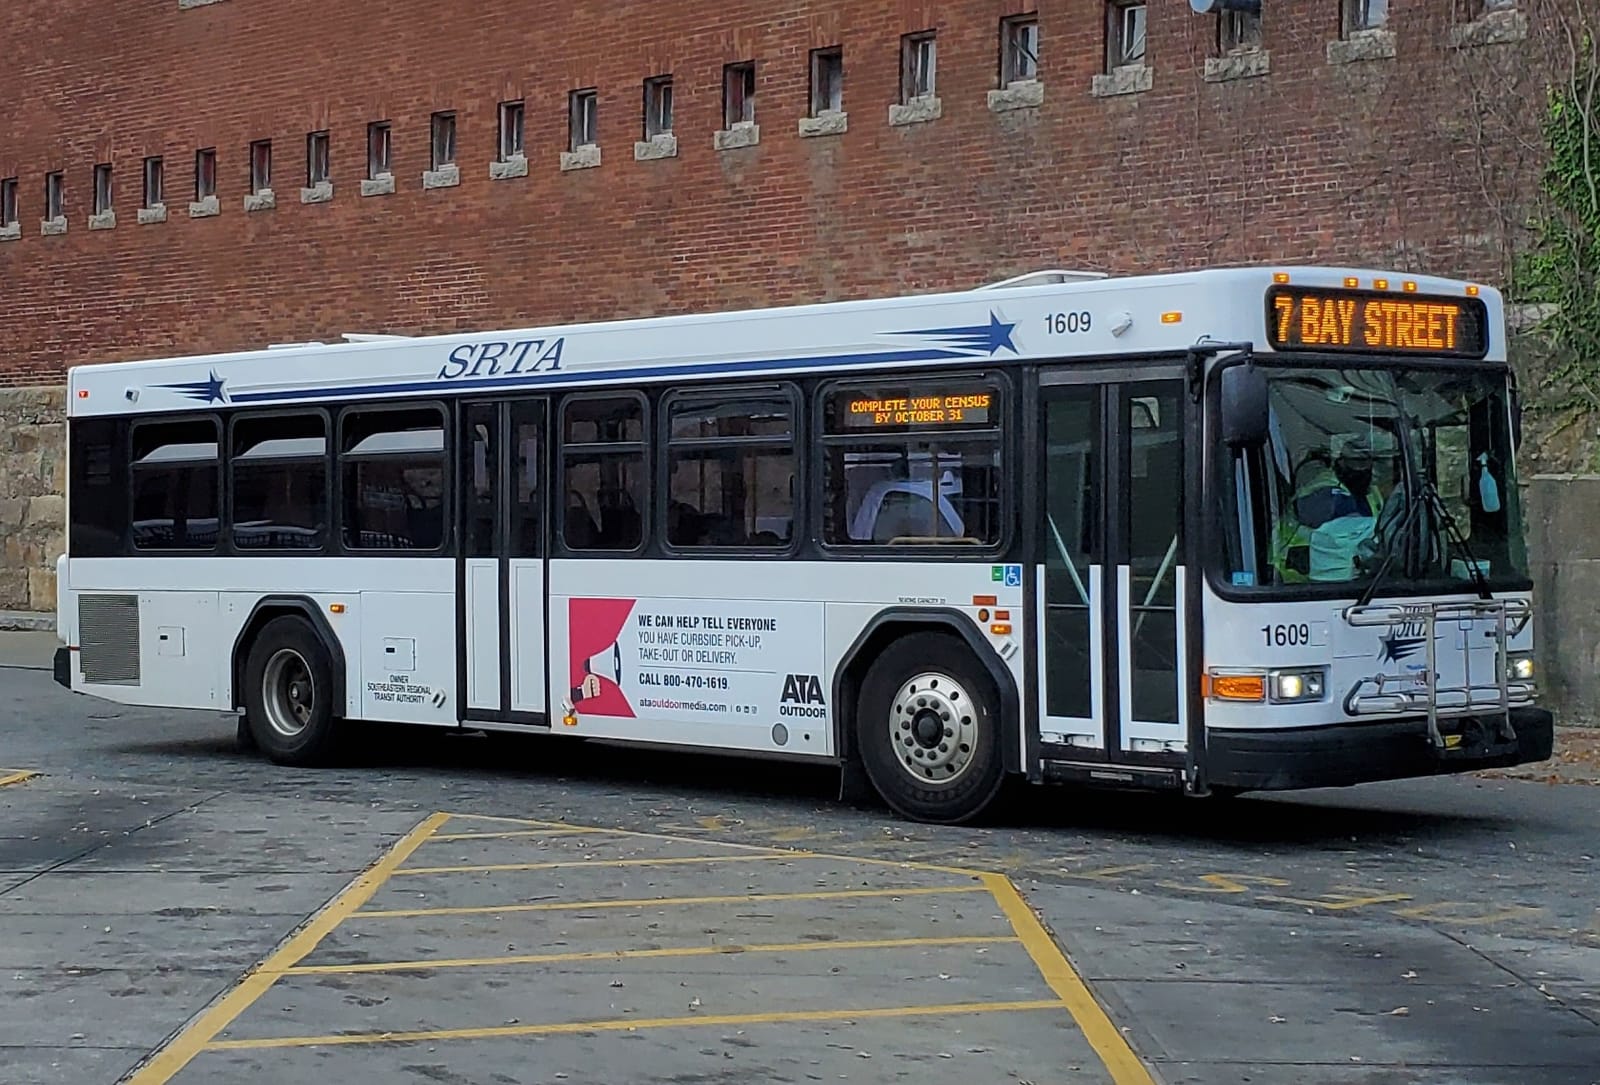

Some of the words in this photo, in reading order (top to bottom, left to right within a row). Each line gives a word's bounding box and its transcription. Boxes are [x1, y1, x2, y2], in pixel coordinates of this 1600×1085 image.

[1044, 311, 1091, 335] 1609
[1274, 296, 1294, 342] 7
[1301, 297, 1356, 344] BAY
[1363, 301, 1459, 349] STREET
[437, 337, 565, 379] SRTA
[851, 400, 907, 413] COMPLETE
[912, 398, 941, 411] YOUR
[944, 395, 989, 408] CENSUS
[875, 413, 891, 424] BY
[895, 411, 945, 423] OCTOBER
[949, 409, 963, 420] 31
[638, 615, 653, 628] WE
[655, 615, 674, 628] CAN
[676, 616, 700, 629] HELP
[702, 617, 725, 630] TELL
[727, 618, 777, 632] EVERYONE
[638, 631, 656, 644] YOU
[657, 632, 679, 645] HAVE
[681, 633, 723, 647] CURBSIDE
[725, 635, 763, 650] PICK-UP,
[1261, 623, 1310, 647] 1609
[638, 647, 680, 662] TAKE-OUT
[681, 649, 695, 661] OR
[696, 650, 738, 665] DELIVERY.
[639, 672, 662, 686] CALL
[780, 674, 826, 705] ATA
[639, 698, 727, 712] ataoutdoormedia.com
[780, 705, 826, 718] OUTDOOR
